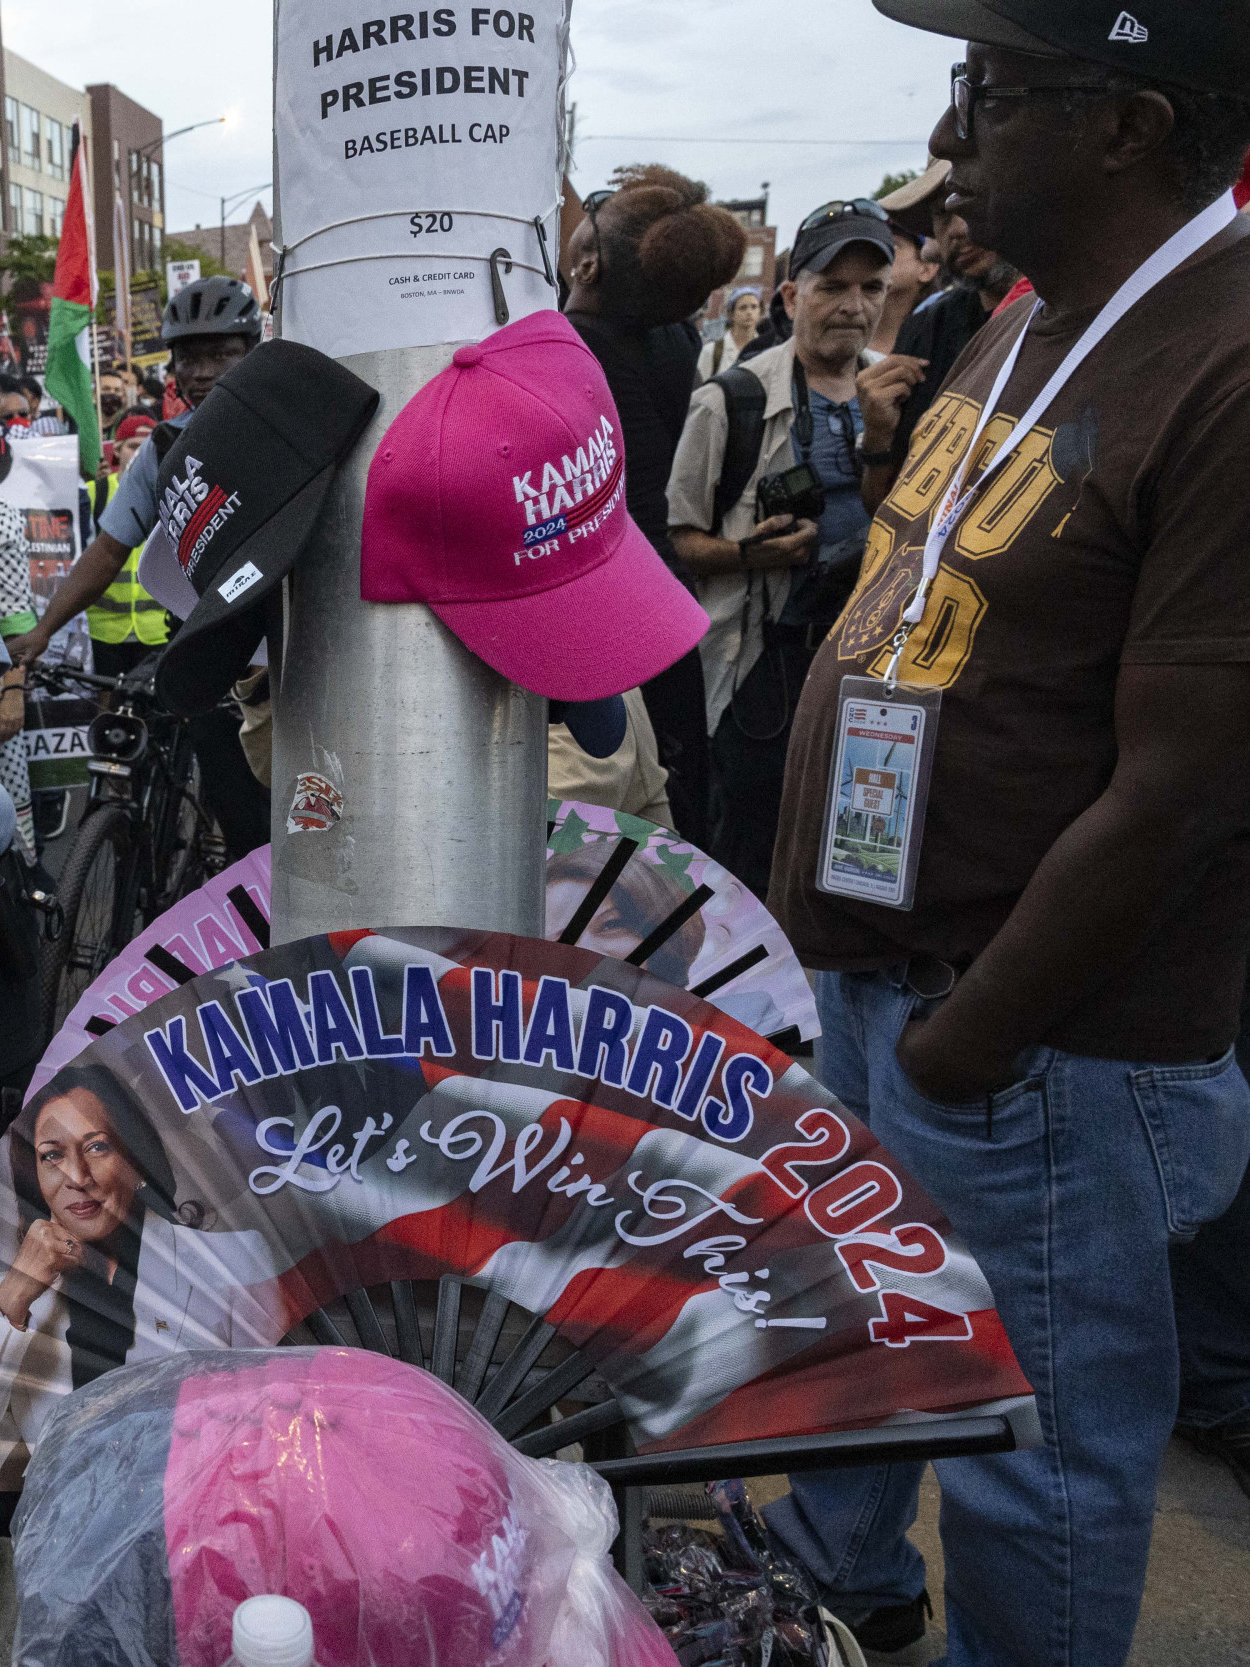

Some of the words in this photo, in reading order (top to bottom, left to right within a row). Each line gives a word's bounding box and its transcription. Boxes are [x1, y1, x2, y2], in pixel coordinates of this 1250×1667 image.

[313, 8, 457, 68] HARRIS
[471, 8, 535, 44] FOR
[320, 65, 529, 120] PRESIDENT
[344, 123, 462, 160] BASEBALL
[468, 122, 511, 144] CAP
[409, 212, 453, 238] $20
[388, 276, 411, 286] CASH
[412, 274, 420, 283] &
[422, 272, 451, 282] CREDIT
[453, 271, 476, 281] CARD
[400, 290, 425, 299] BOSTON,
[426, 289, 438, 297] MA
[512, 414, 614, 503] KAMALA
[524, 439, 617, 526] HARRIS
[523, 518, 566, 545] 2024
[513, 539, 560, 566] FOR
[858, 730, 903, 741] WEDNESDAY
[862, 787, 884, 800] SPECIAL
[143, 962, 456, 1114] KAMALA
[470, 965, 774, 1143] HARRIS
[758, 1107, 974, 1348] 2024
[249, 1105, 393, 1195] Let's
[420, 1109, 616, 1208] Win
[614, 1170, 828, 1330] This!
